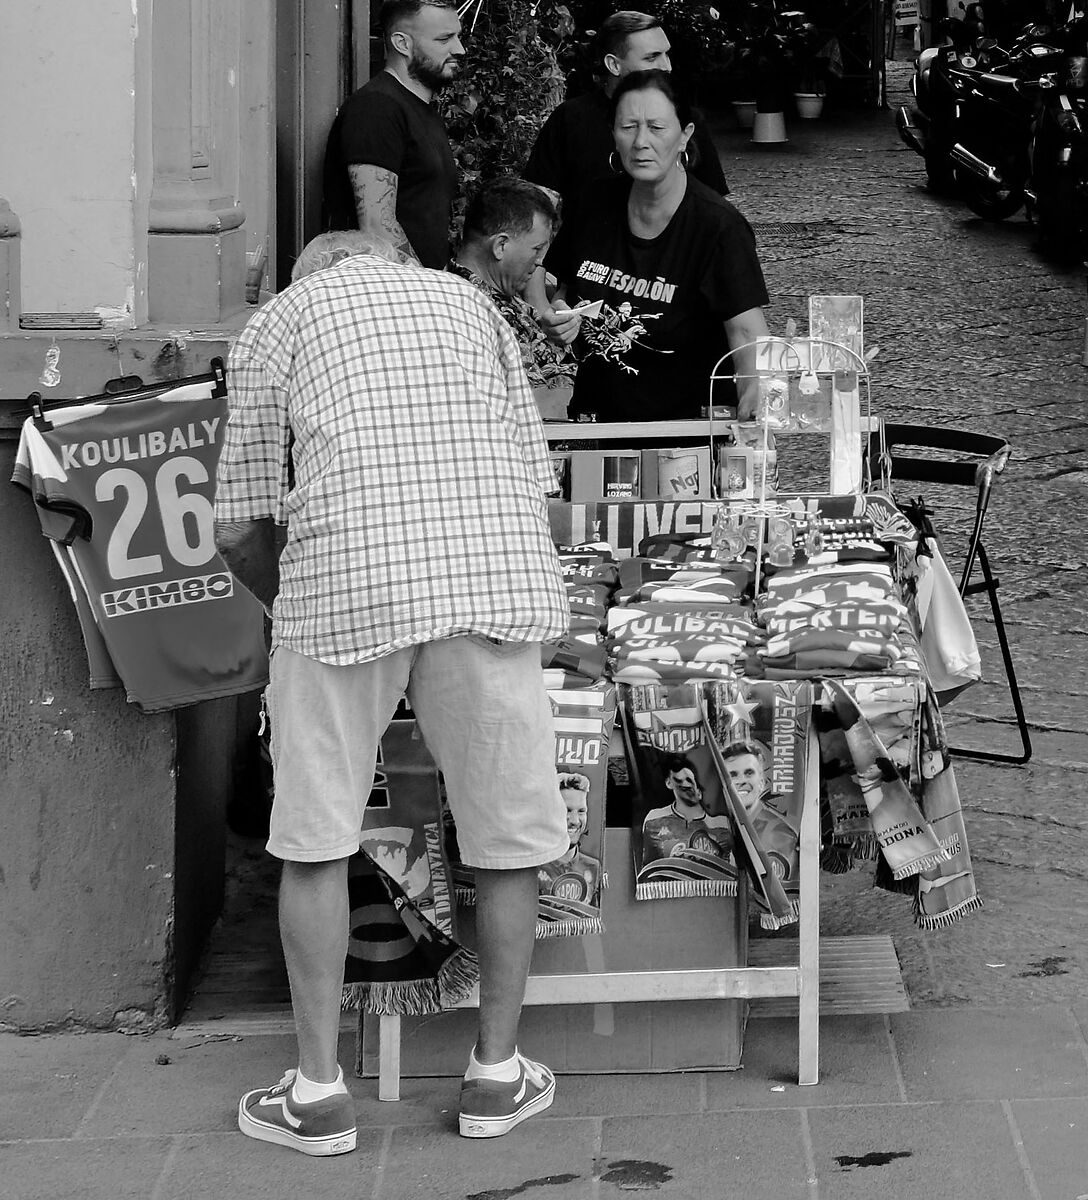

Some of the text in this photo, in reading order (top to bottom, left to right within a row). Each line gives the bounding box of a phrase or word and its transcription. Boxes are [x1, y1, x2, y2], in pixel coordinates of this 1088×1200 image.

[582, 271, 606, 285] AGAVE
[588, 261, 610, 276] PURO
[60, 417, 221, 471] KOULIBALY
[95, 455, 218, 580] 26
[766, 608, 901, 634] MERTEN
[555, 738, 600, 765] DRI
